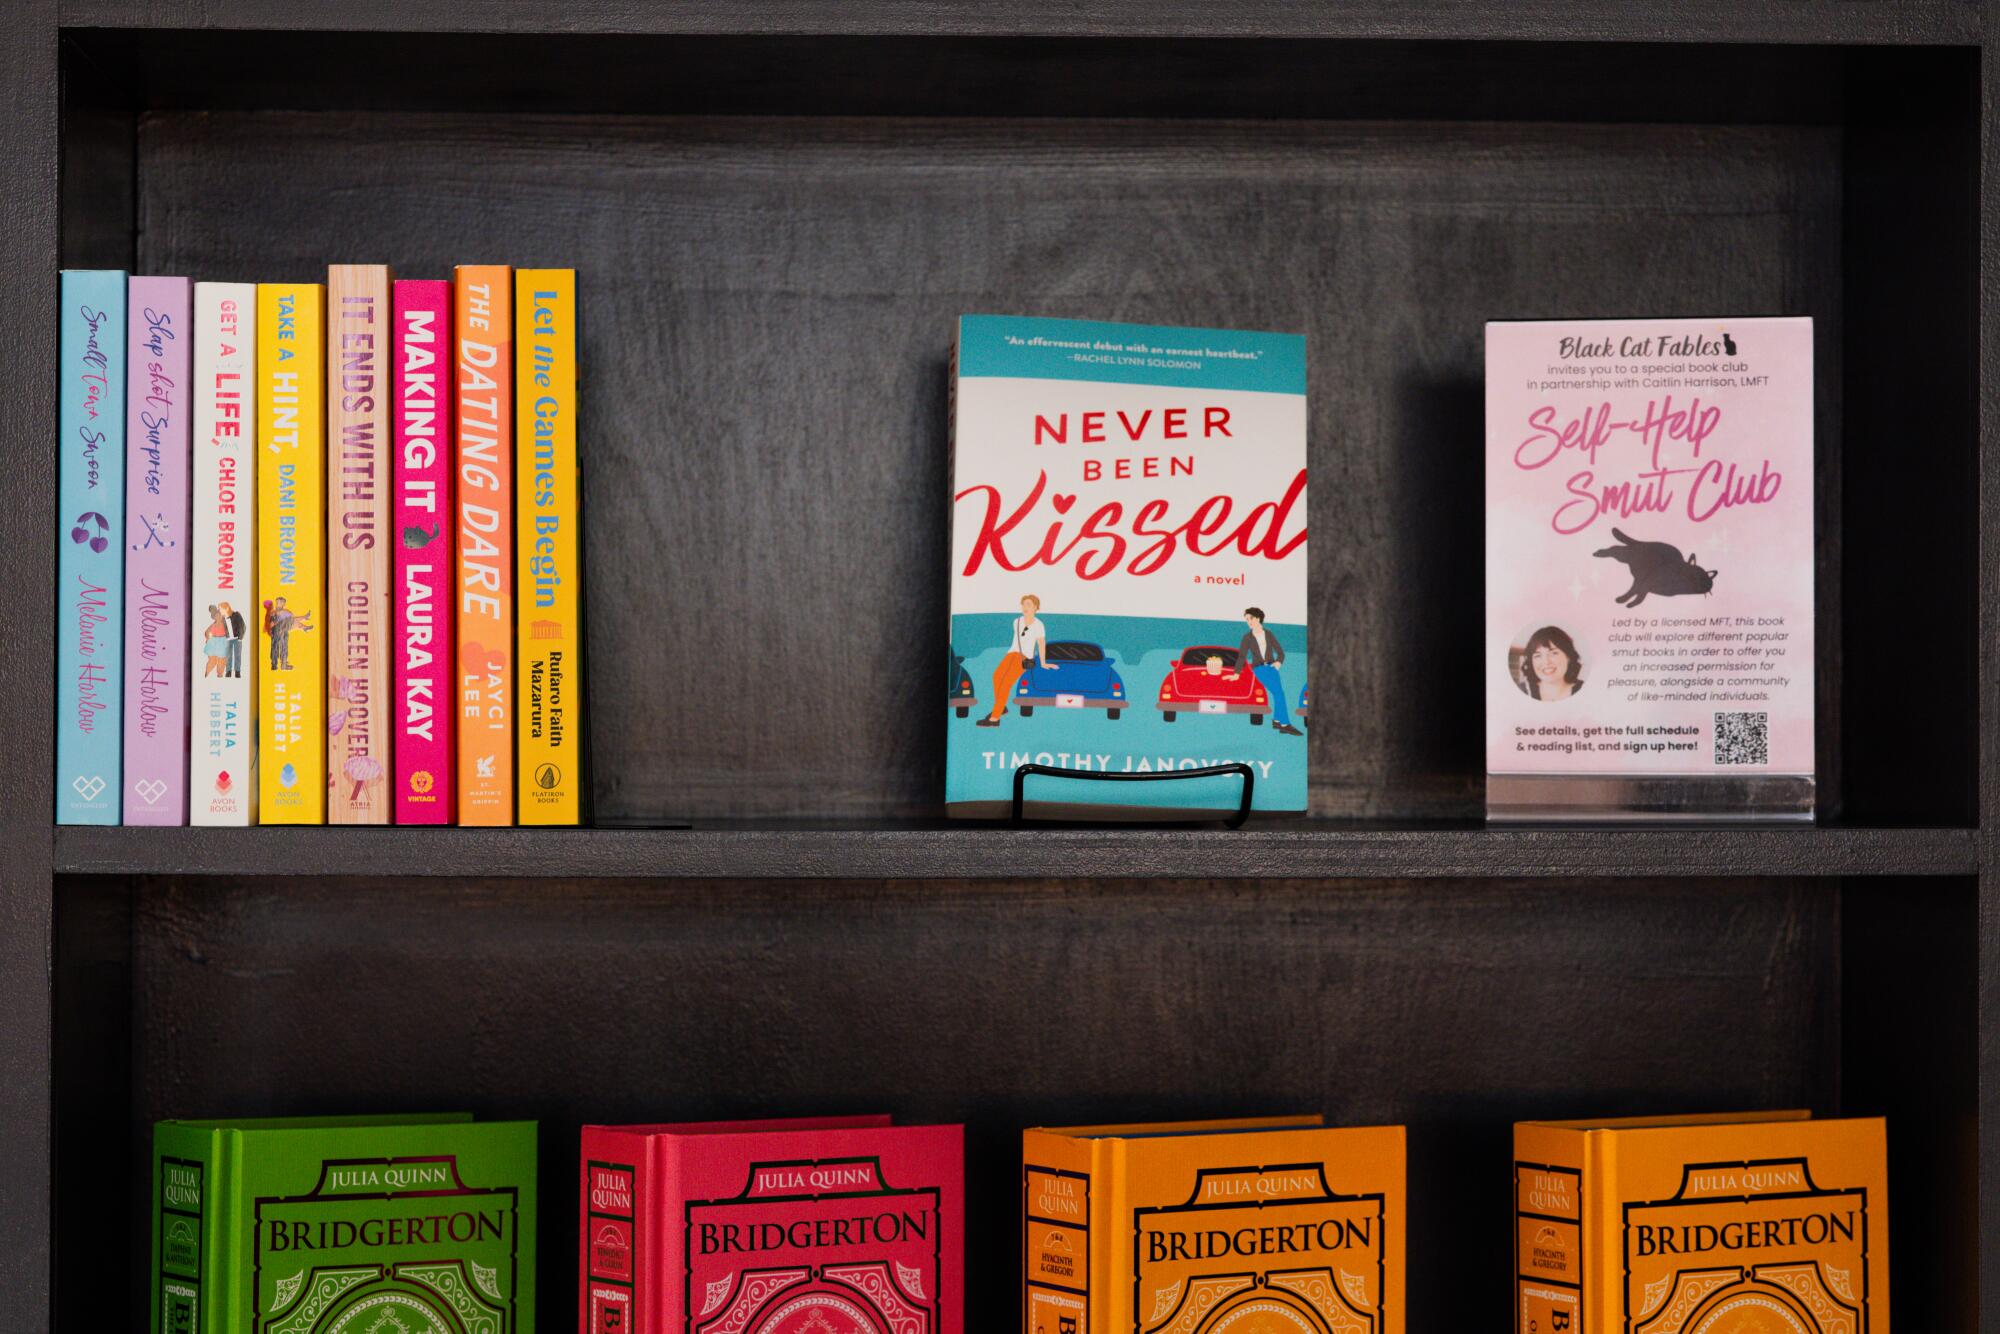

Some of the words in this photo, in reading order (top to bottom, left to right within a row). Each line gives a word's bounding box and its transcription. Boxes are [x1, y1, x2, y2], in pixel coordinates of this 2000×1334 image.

[220, 300, 237, 336] GET
[277, 294, 295, 341] TAKE
[342, 296, 374, 324] IT
[468, 284, 490, 331] THE
[533, 290, 558, 336] Let
[81, 305, 108, 369] Small
[144, 307, 175, 357] Slap
[220, 343, 237, 357] A
[1027, 338, 1091, 350] effervescent
[1093, 340, 1123, 351] debut
[1125, 343, 1149, 353] with
[1151, 346, 1164, 355] an
[1165, 347, 1203, 358] earnest
[1559, 336, 1615, 360] Black
[1620, 335, 1653, 358] Cat
[1656, 333, 1722, 358] Fables
[278, 348, 295, 361] A
[342, 333, 375, 413] ENDS
[534, 344, 555, 388] the
[1117, 356, 1145, 367] LYNN
[1147, 358, 1202, 370] SOLOMON
[1547, 363, 1586, 375] invites
[1589, 366, 1612, 378] you
[1614, 364, 1627, 374] to
[1630, 365, 1639, 374] a
[1641, 361, 1685, 376] special
[1688, 361, 1719, 373] book
[1722, 361, 1748, 373] club
[404, 310, 436, 470] MAKING
[1527, 379, 1539, 390] in
[1540, 377, 1611, 393] partnership
[1614, 376, 1640, 389] with
[1642, 376, 1682, 388] Caitlin
[1684, 375, 1738, 389] Harrison,
[1740, 375, 1769, 387] LMFT
[211, 373, 241, 446] LIFE,
[268, 372, 299, 454] HINT,
[460, 338, 500, 492] DATING
[1034, 406, 1233, 446] NEVER
[141, 410, 168, 495] Surprise
[534, 395, 559, 508] Games
[1514, 395, 1721, 470] Self-Help
[80, 426, 106, 489] Swoon
[342, 422, 375, 500] WITH
[1083, 455, 1195, 482] BEEN
[218, 457, 236, 514] CHLOE
[278, 464, 296, 509] DANI
[404, 480, 436, 513] IT
[1552, 467, 1700, 535] Smut
[1687, 459, 1782, 523] Club
[342, 510, 375, 550] US
[954, 467, 1308, 582] Kissed
[217, 521, 235, 590] BROWN
[279, 516, 296, 585] BROWN
[462, 502, 501, 620] DARE
[529, 514, 561, 608] Begin
[1194, 574, 1202, 585] a
[1206, 573, 1246, 586] novel
[78, 574, 108, 657] Melanie
[138, 578, 170, 660] Melanie
[347, 581, 369, 671] COLLEEN
[406, 564, 433, 670] LAURA
[1608, 632, 1632, 642] club
[1635, 632, 1652, 642] will
[1654, 632, 1695, 644] explore
[1697, 631, 1743, 642] different
[1745, 631, 1789, 643] popular
[1611, 618, 1632, 628] Led
[1634, 618, 1648, 629] by
[1650, 619, 1658, 627] a
[1661, 617, 1707, 627] licensed
[1709, 617, 1733, 628] MFT,
[1735, 616, 1755, 627] this
[1757, 616, 1785, 626] book
[1611, 647, 1640, 657] smut
[1642, 647, 1675, 657] books
[1677, 647, 1688, 656] in
[1690, 646, 1721, 657] order
[1723, 647, 1734, 656] to
[1736, 646, 1762, 657] offer
[1764, 648, 1786, 659] you
[1622, 663, 1637, 672] an
[1640, 661, 1694, 672] increased
[1696, 661, 1757, 673] permission
[1759, 661, 1775, 671] for
[78, 663, 107, 735] Harlow
[464, 674, 480, 718] LEE
[487, 661, 505, 729] JAYCI
[531, 660, 545, 739] Mazarura
[549, 650, 563, 705] Rufaro
[1607, 677, 1657, 688] pleasure,
[1660, 676, 1714, 689] alongside
[1716, 678, 1725, 687] a
[1727, 676, 1791, 688] community
[1627, 691, 1639, 702] of
[1640, 691, 1707, 702] like-minded
[1709, 690, 1770, 702] individuals.
[139, 666, 169, 738] Harlow
[274, 683, 286, 753] HIBBERT
[289, 693, 301, 743] TALIA
[347, 678, 369, 758] HOOVER
[406, 678, 433, 742] KAY
[209, 692, 221, 757] HIBBERT
[225, 701, 237, 749] TALIA
[549, 708, 563, 748] Faith
[1515, 726, 1536, 736] See
[1538, 726, 1581, 737] details,
[1583, 726, 1602, 738] get
[1604, 726, 1624, 736] the
[1626, 725, 1644, 736] full
[1646, 725, 1700, 736] schedule
[982, 751, 1112, 773] TIMOTHY
[1516, 742, 1526, 752] &
[1527, 741, 1573, 754] reading
[1575, 740, 1595, 752] list,
[1598, 740, 1621, 751] and
[1623, 740, 1648, 754] sign
[1650, 743, 1665, 755] up
[1668, 740, 1699, 751] here!
[210, 805, 238, 813] BOOKS
[212, 798, 236, 806] AVON
[407, 795, 437, 803] VINTAGE
[165, 1185, 200, 1205] QUINN
[170, 1168, 196, 1187] JULIA
[331, 1169, 379, 1191] JULIA
[384, 1168, 447, 1189] QUINN
[592, 1189, 631, 1209] QUINN
[597, 1173, 626, 1192] JULIA
[758, 1171, 804, 1193] JULIA
[809, 1168, 871, 1190] QUINN
[1044, 1178, 1074, 1197] JULIA
[1206, 1179, 1252, 1199] JULIA
[1256, 1175, 1317, 1197] QUINN
[1535, 1175, 1565, 1193] JULIA
[1693, 1174, 1737, 1194] JULIA
[1742, 1171, 1801, 1191] QUINN
[1039, 1194, 1079, 1215] QUINN
[1529, 1191, 1570, 1210] QUINN
[268, 1209, 504, 1253] BRIDGERTON
[699, 1209, 928, 1256] BRIDGERTON
[1147, 1215, 1373, 1263] BRIDGERTON
[1635, 1210, 1855, 1258] BRIDGERTON
